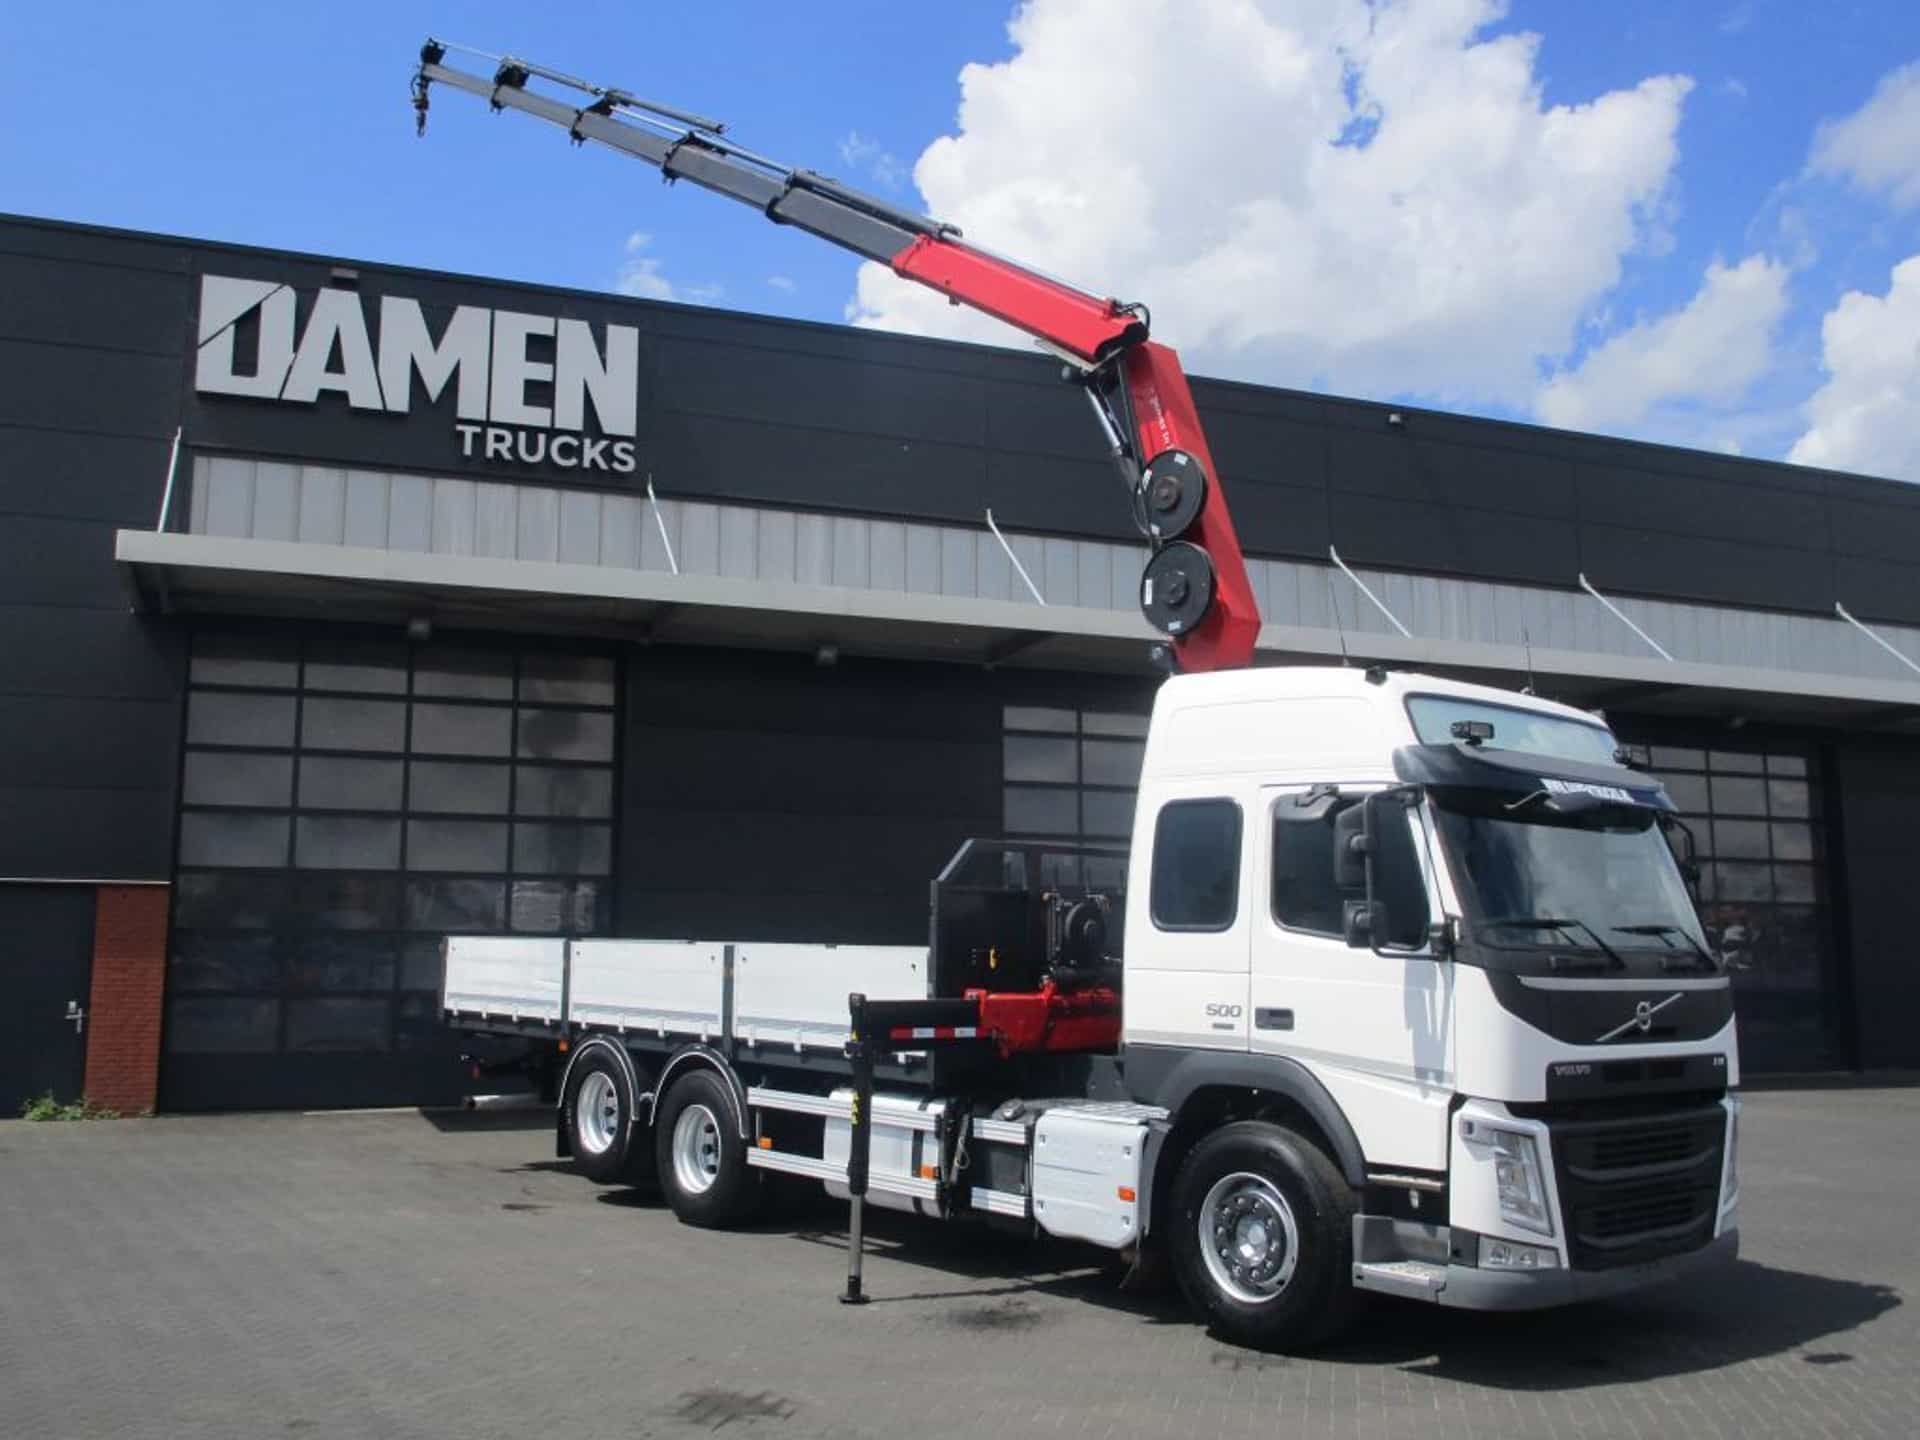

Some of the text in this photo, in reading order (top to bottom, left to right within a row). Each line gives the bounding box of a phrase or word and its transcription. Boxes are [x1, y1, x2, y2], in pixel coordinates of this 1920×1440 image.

[195, 273, 640, 438] DAMEN
[456, 425, 637, 473] TRUCKS
[1206, 1003, 1242, 1018] 500
